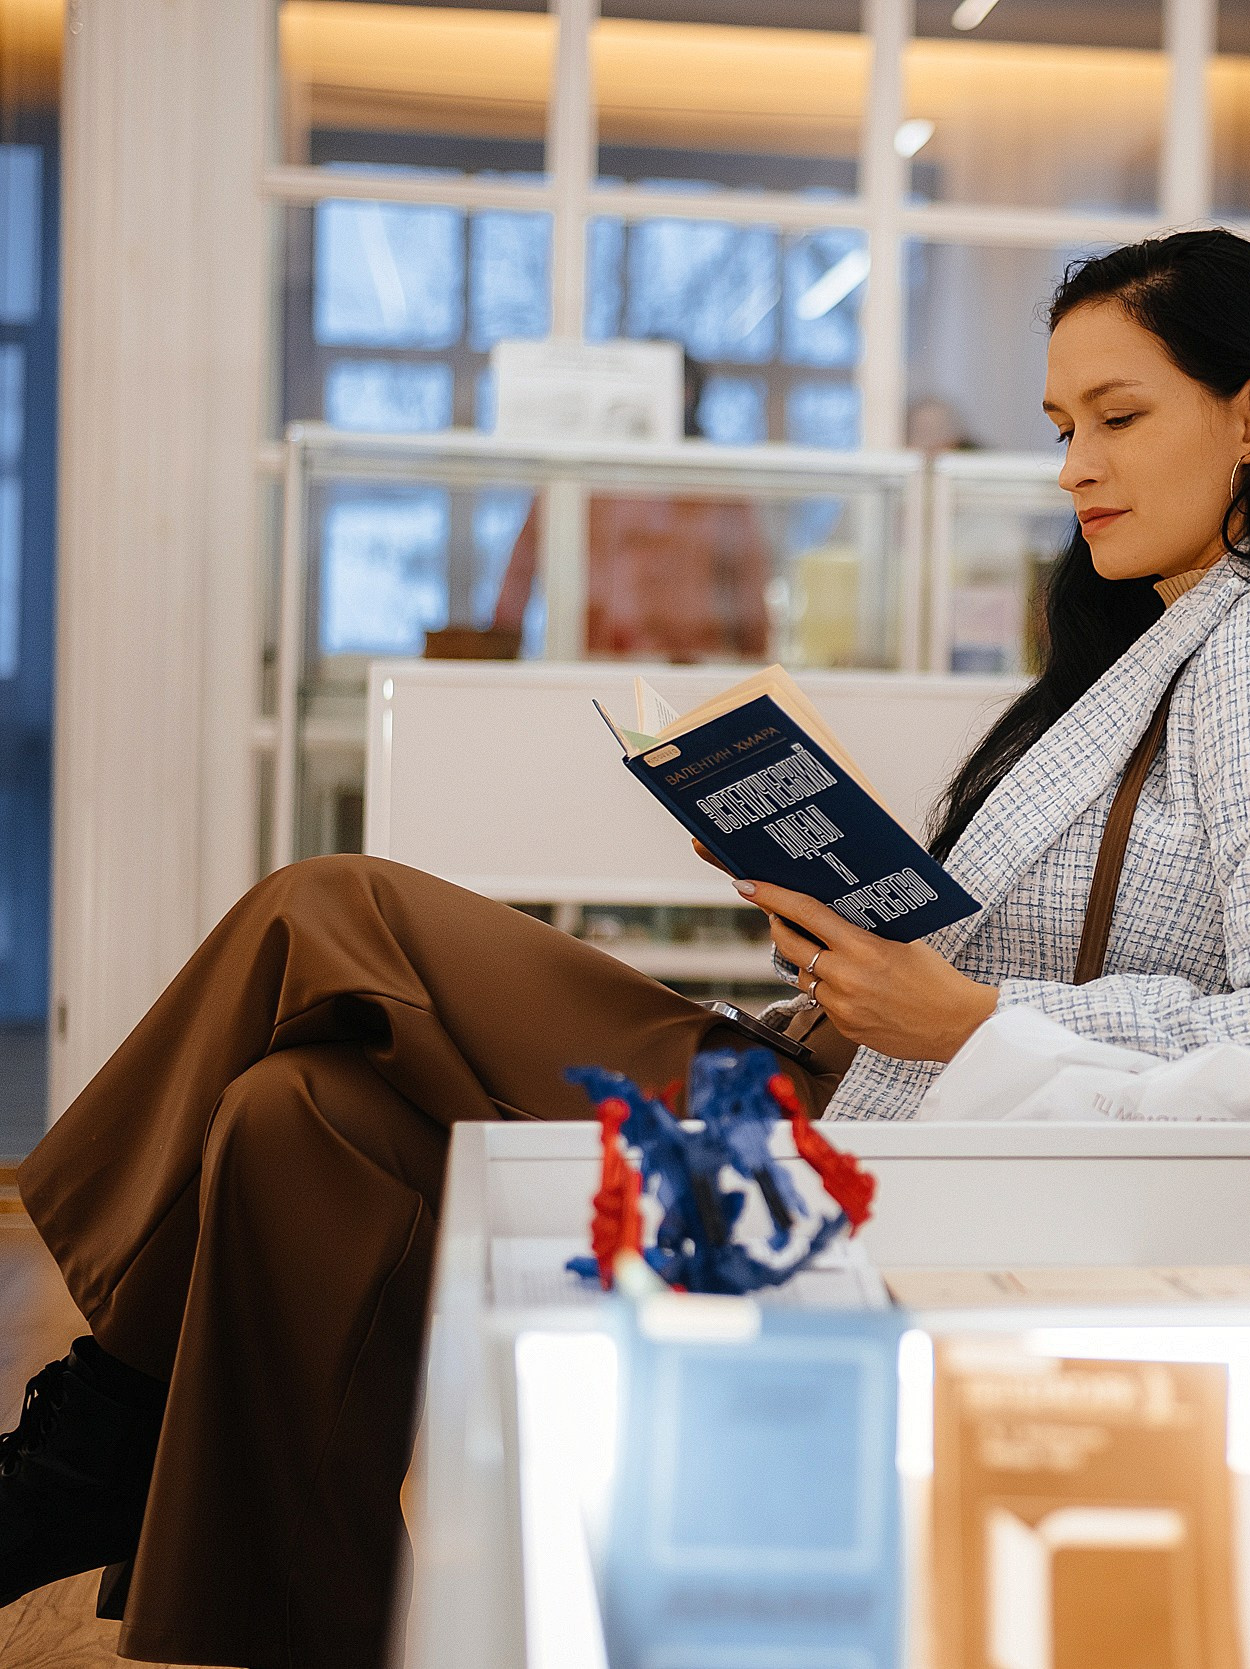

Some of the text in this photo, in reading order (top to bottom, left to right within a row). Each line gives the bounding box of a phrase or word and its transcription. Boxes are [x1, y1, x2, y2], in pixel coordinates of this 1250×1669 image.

[665, 748, 733, 786] ВАЛЕНТИН
[733, 726, 781, 753] ХМАРА
[696, 743, 838, 834] ЭСТЕТИЧЕСКИЙ
[763, 804, 845, 860] ИДЕАЛ
[822, 852, 859, 885] И
[826, 867, 939, 931] ОРЧЕСТВО
